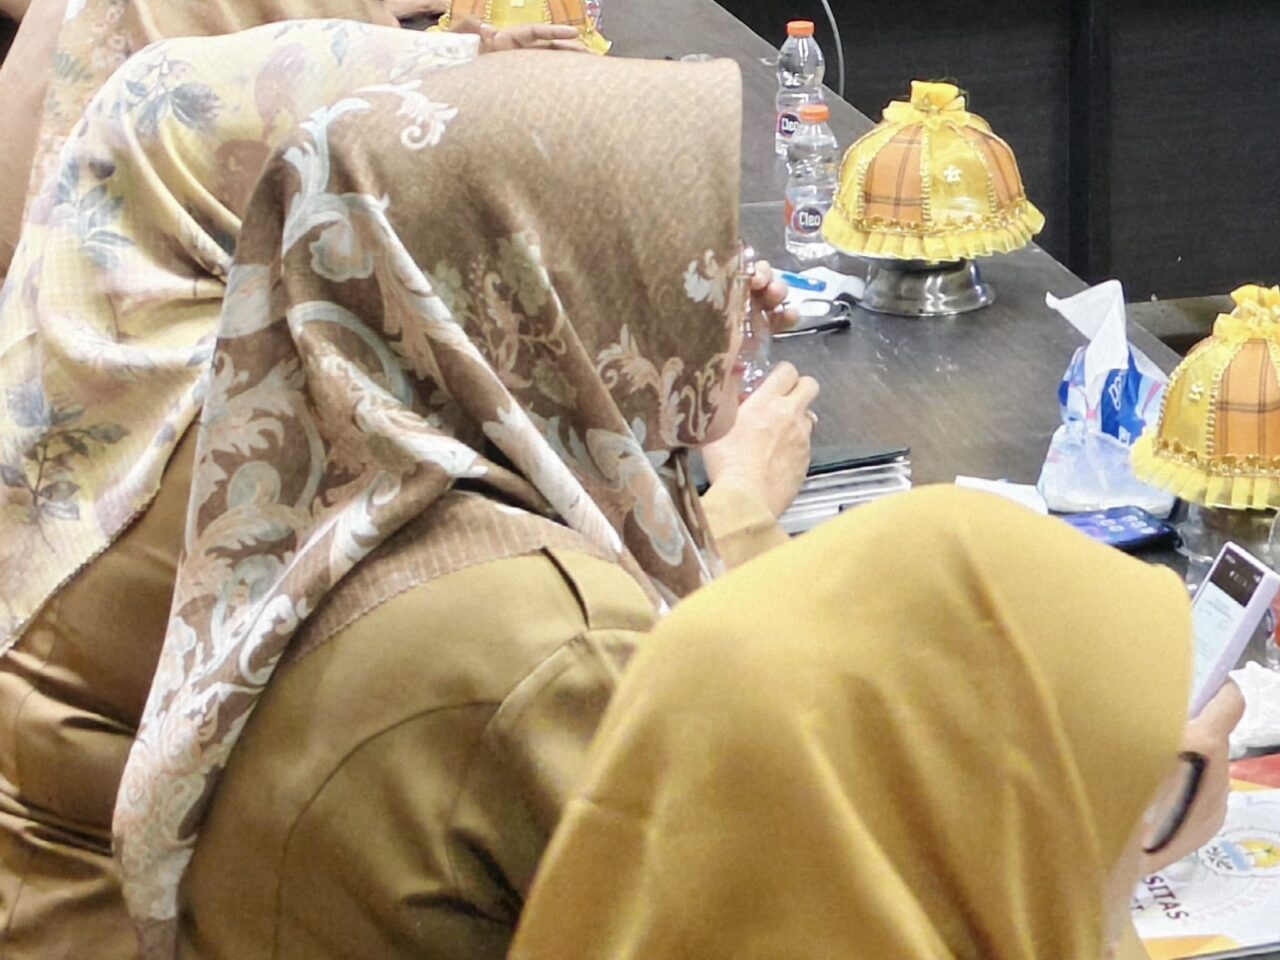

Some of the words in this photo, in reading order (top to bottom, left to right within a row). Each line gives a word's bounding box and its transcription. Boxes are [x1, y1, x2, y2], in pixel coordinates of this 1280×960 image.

[781, 117, 801, 131] Cleo
[799, 212, 821, 226] Cleo
[1142, 875, 1190, 920] SITAS
